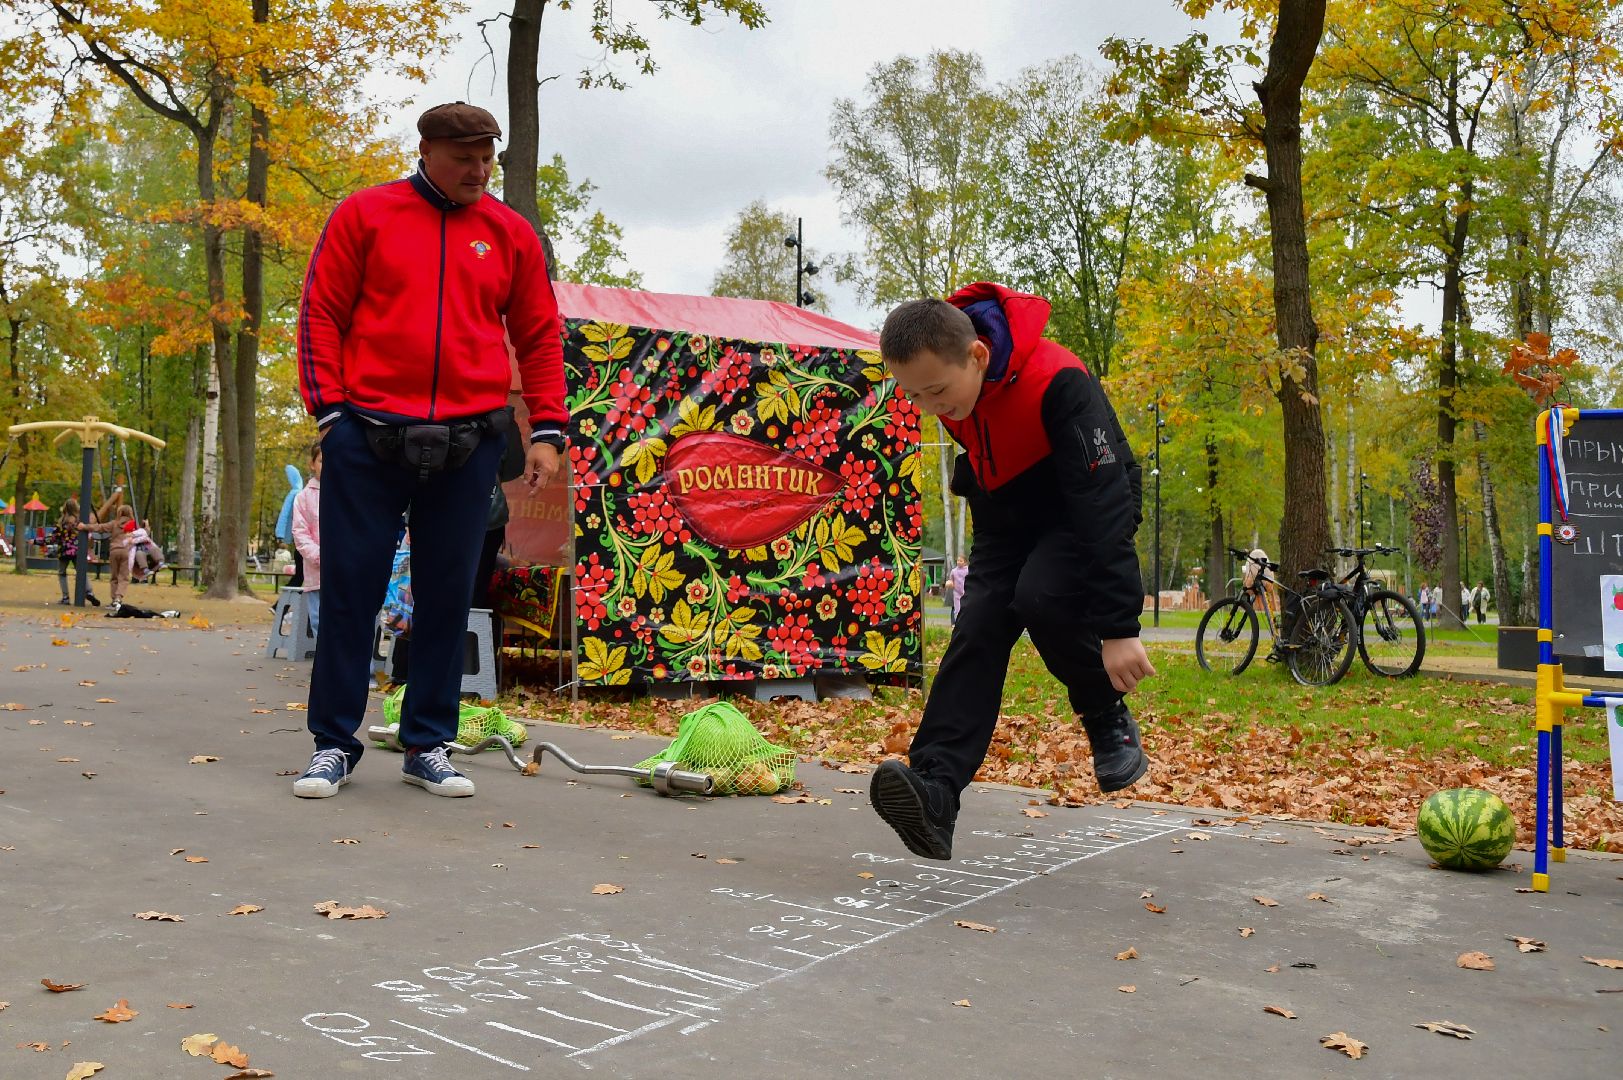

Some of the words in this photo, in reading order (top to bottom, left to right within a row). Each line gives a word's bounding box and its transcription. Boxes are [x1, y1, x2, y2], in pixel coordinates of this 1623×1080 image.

[1568, 439, 1623, 464] ПРЫ
[677, 463, 824, 496] РОМАНТИК
[301, 1012, 436, 1063] 250
